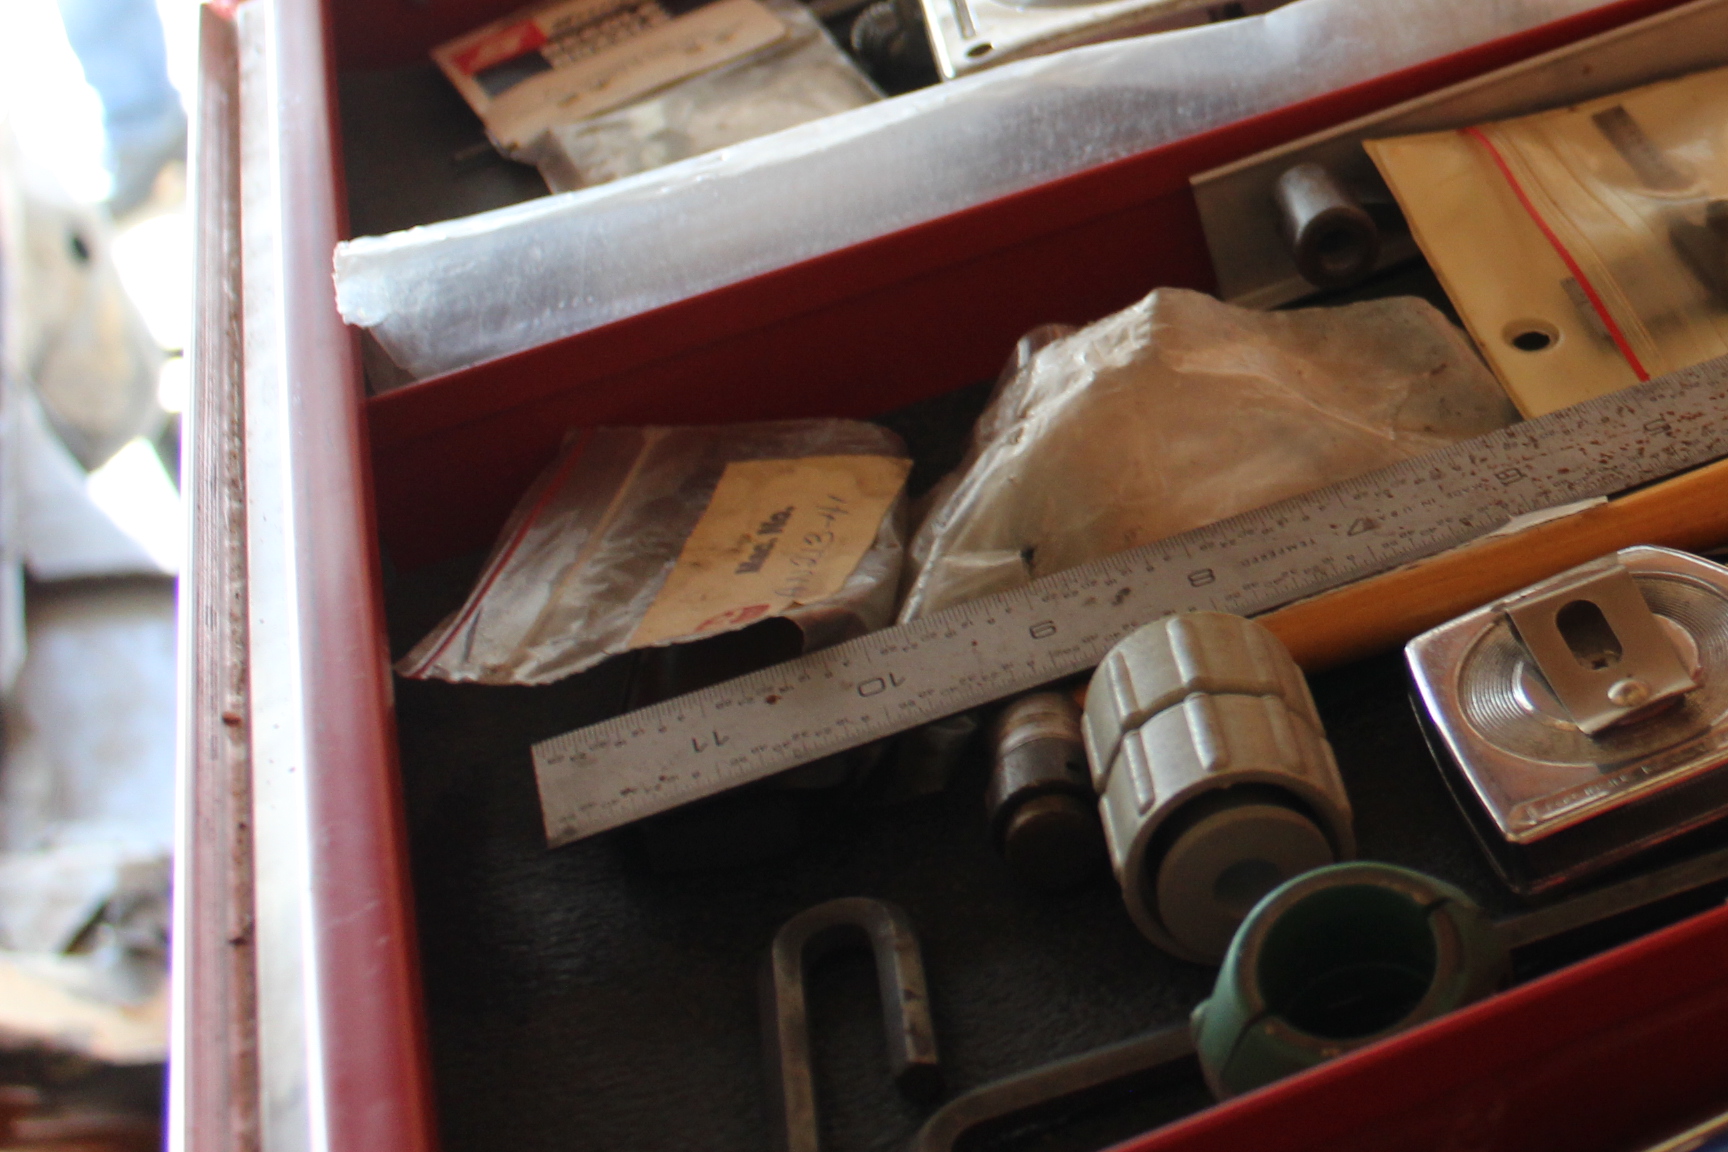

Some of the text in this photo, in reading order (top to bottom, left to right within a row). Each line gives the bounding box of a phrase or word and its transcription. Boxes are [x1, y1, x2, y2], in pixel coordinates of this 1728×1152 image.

[1346, 516, 1380, 537] 7
[1187, 568, 1216, 588] 8
[1029, 619, 1058, 640] 9
[857, 671, 906, 698] 10
[691, 729, 730, 753] 11
